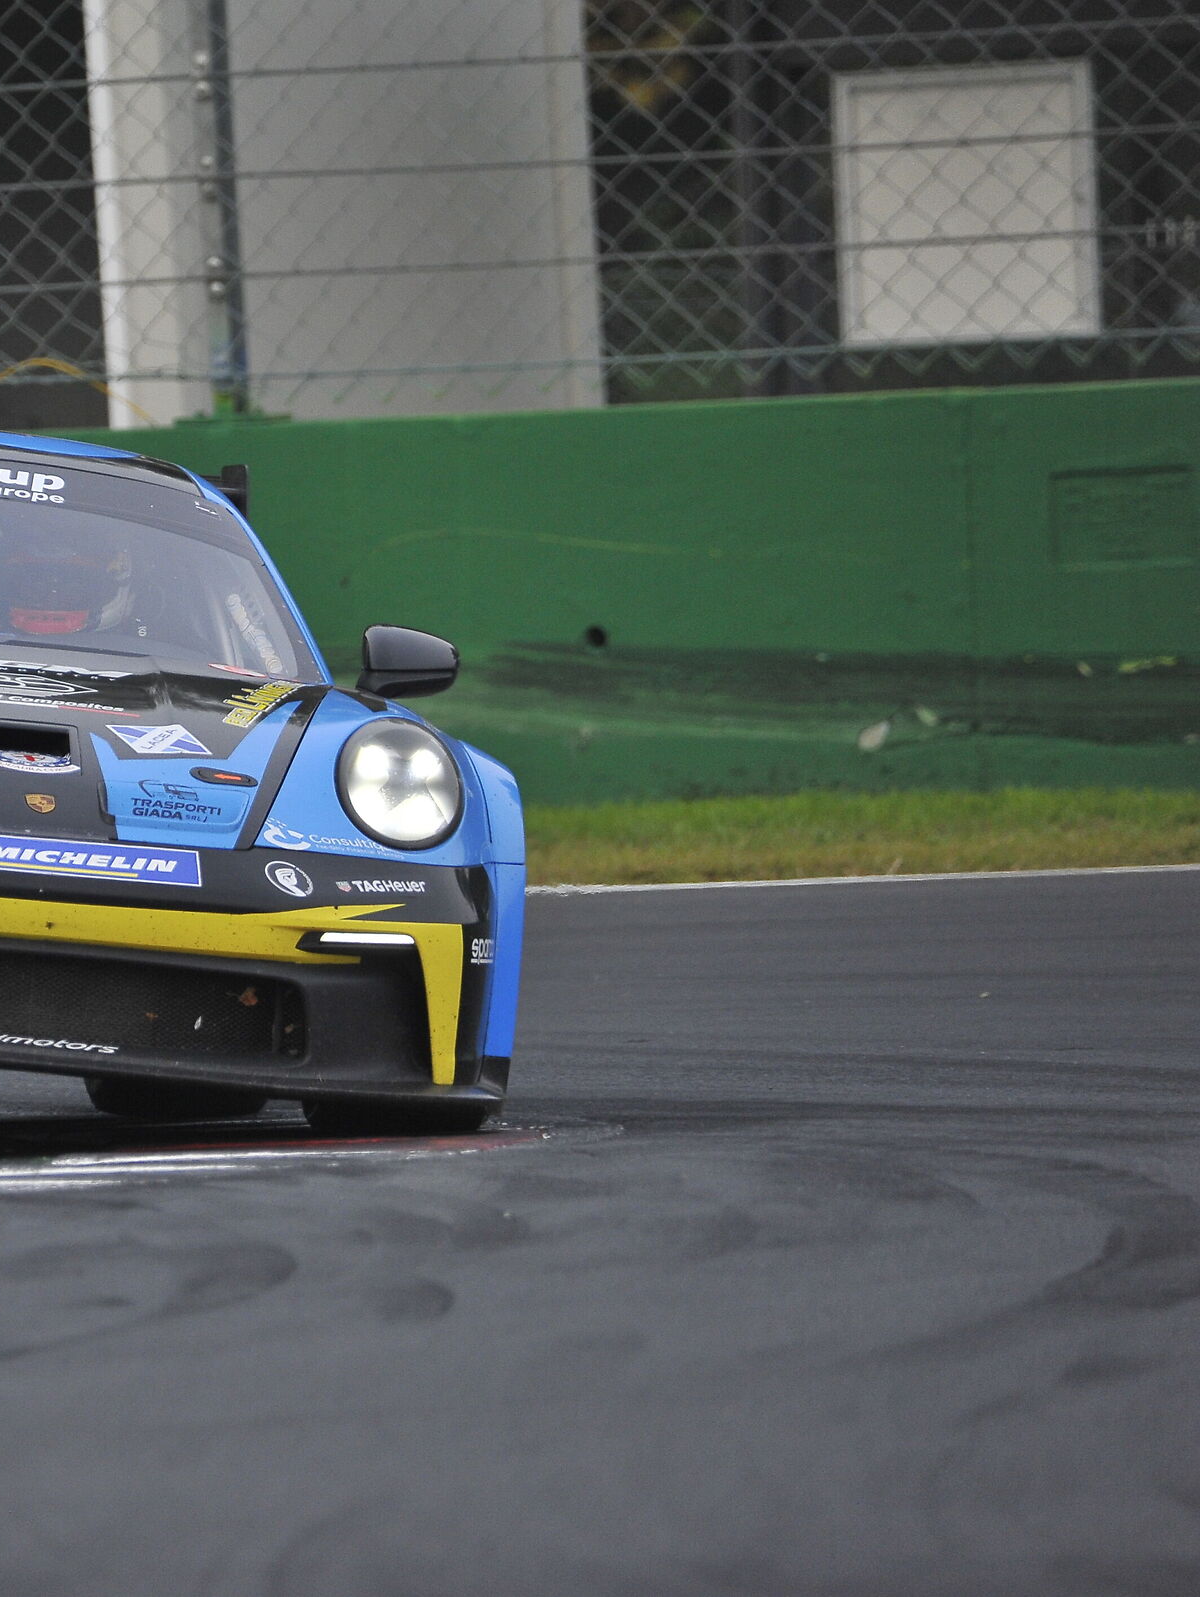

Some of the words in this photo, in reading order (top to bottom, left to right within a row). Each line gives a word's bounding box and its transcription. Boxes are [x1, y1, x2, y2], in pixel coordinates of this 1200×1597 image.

[7, 694, 126, 713] Composites
[140, 727, 177, 750] LACEA
[130, 797, 222, 816] TRASPORTI
[132, 807, 183, 821] GIADA
